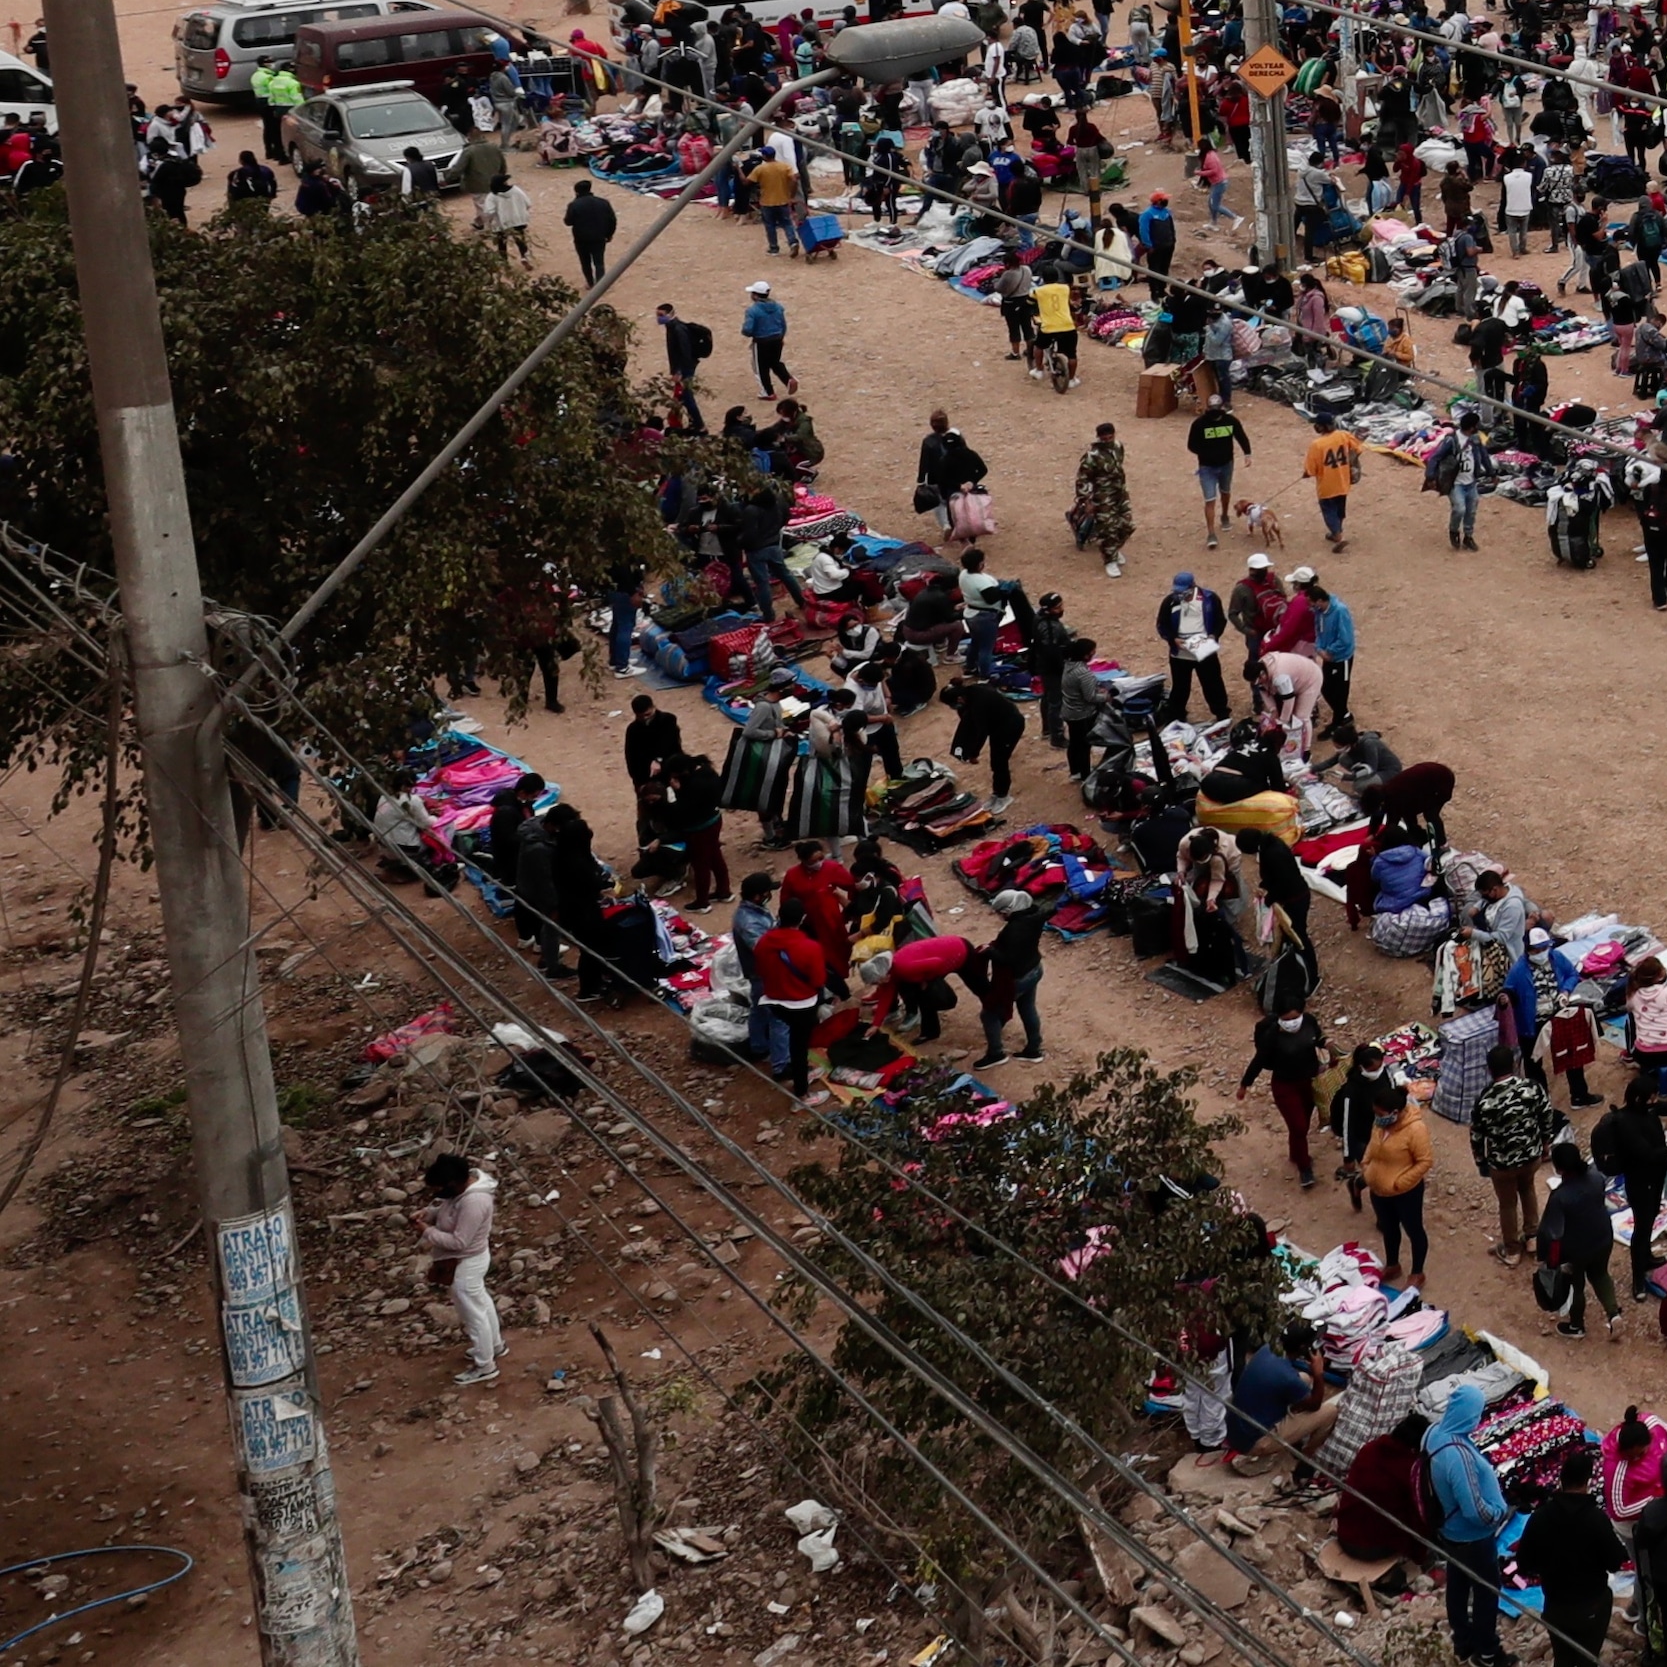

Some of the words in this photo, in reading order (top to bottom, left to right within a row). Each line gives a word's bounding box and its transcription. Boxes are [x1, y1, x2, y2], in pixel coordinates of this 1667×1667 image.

[1323, 445, 1348, 468] 44
[223, 1216, 282, 1252] ATRASO
[226, 1308, 278, 1335] ATRA
[244, 1390, 304, 1421] ATRO
